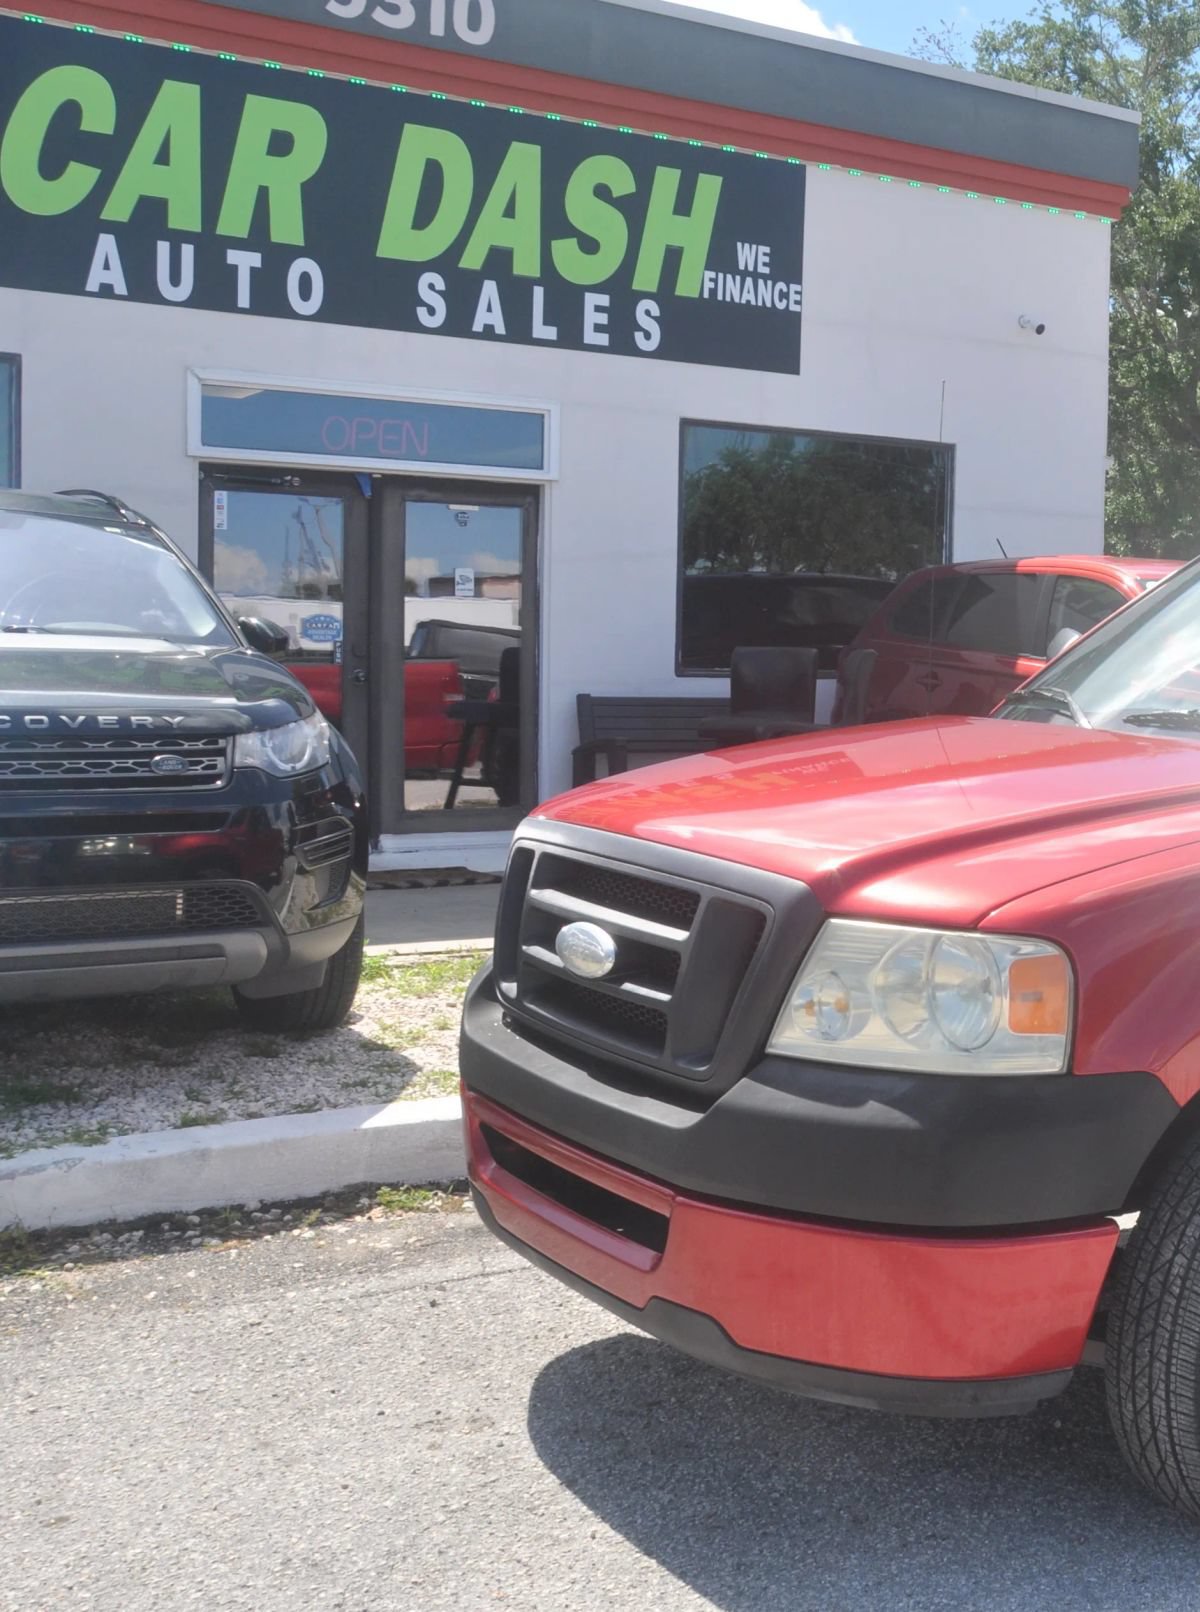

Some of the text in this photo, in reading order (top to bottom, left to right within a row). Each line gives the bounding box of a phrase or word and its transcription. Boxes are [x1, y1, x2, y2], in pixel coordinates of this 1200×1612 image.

[0, 64, 724, 299] CAR DASH
[736, 241, 772, 275] WE
[84, 232, 662, 353] AUTO SALES
[702, 269, 803, 313] FINANCE
[320, 414, 430, 457] OPEN
